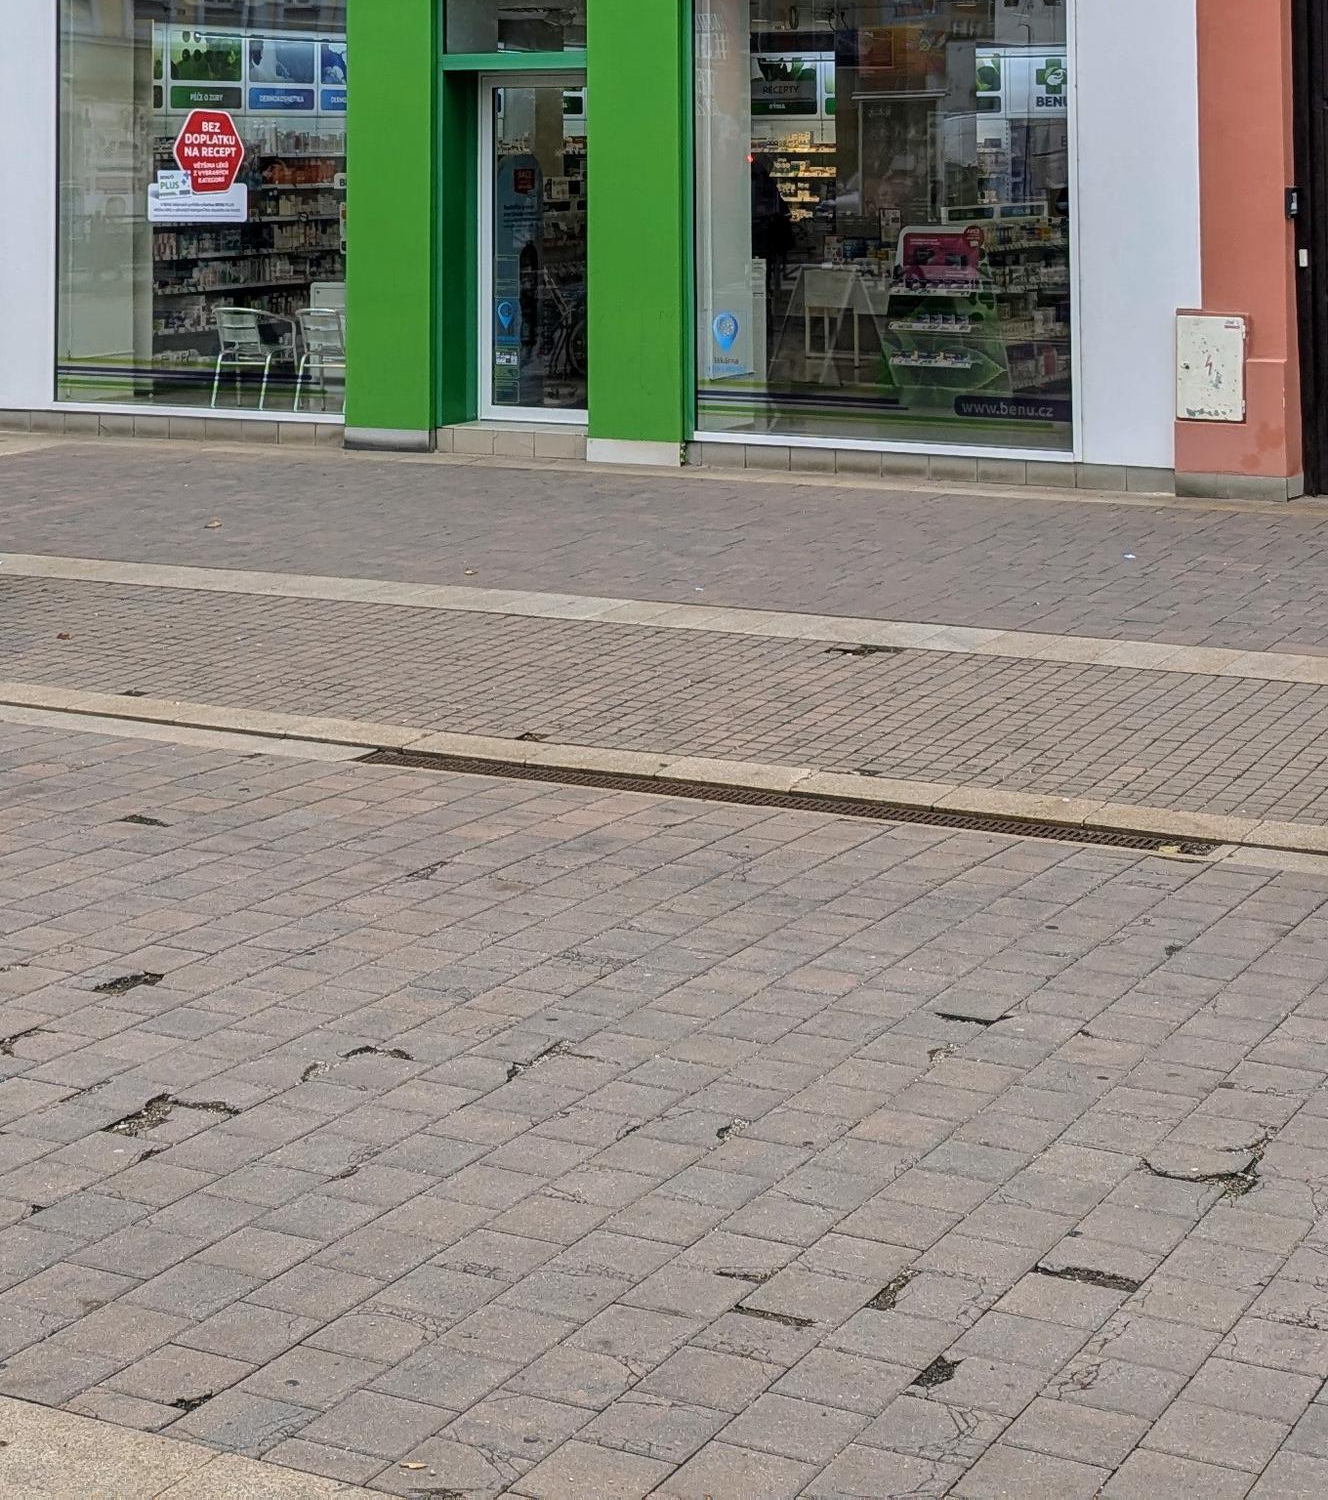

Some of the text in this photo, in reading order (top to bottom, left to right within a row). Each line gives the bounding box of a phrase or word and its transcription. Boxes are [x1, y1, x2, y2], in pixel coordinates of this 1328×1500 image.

[201, 122, 220, 132] BEZ
[184, 135, 235, 145] DOPLATKU
[184, 146, 236, 157] NA RECEPT
[160, 181, 179, 190] PLUS
[961, 401, 1054, 417] www.benu.cz
